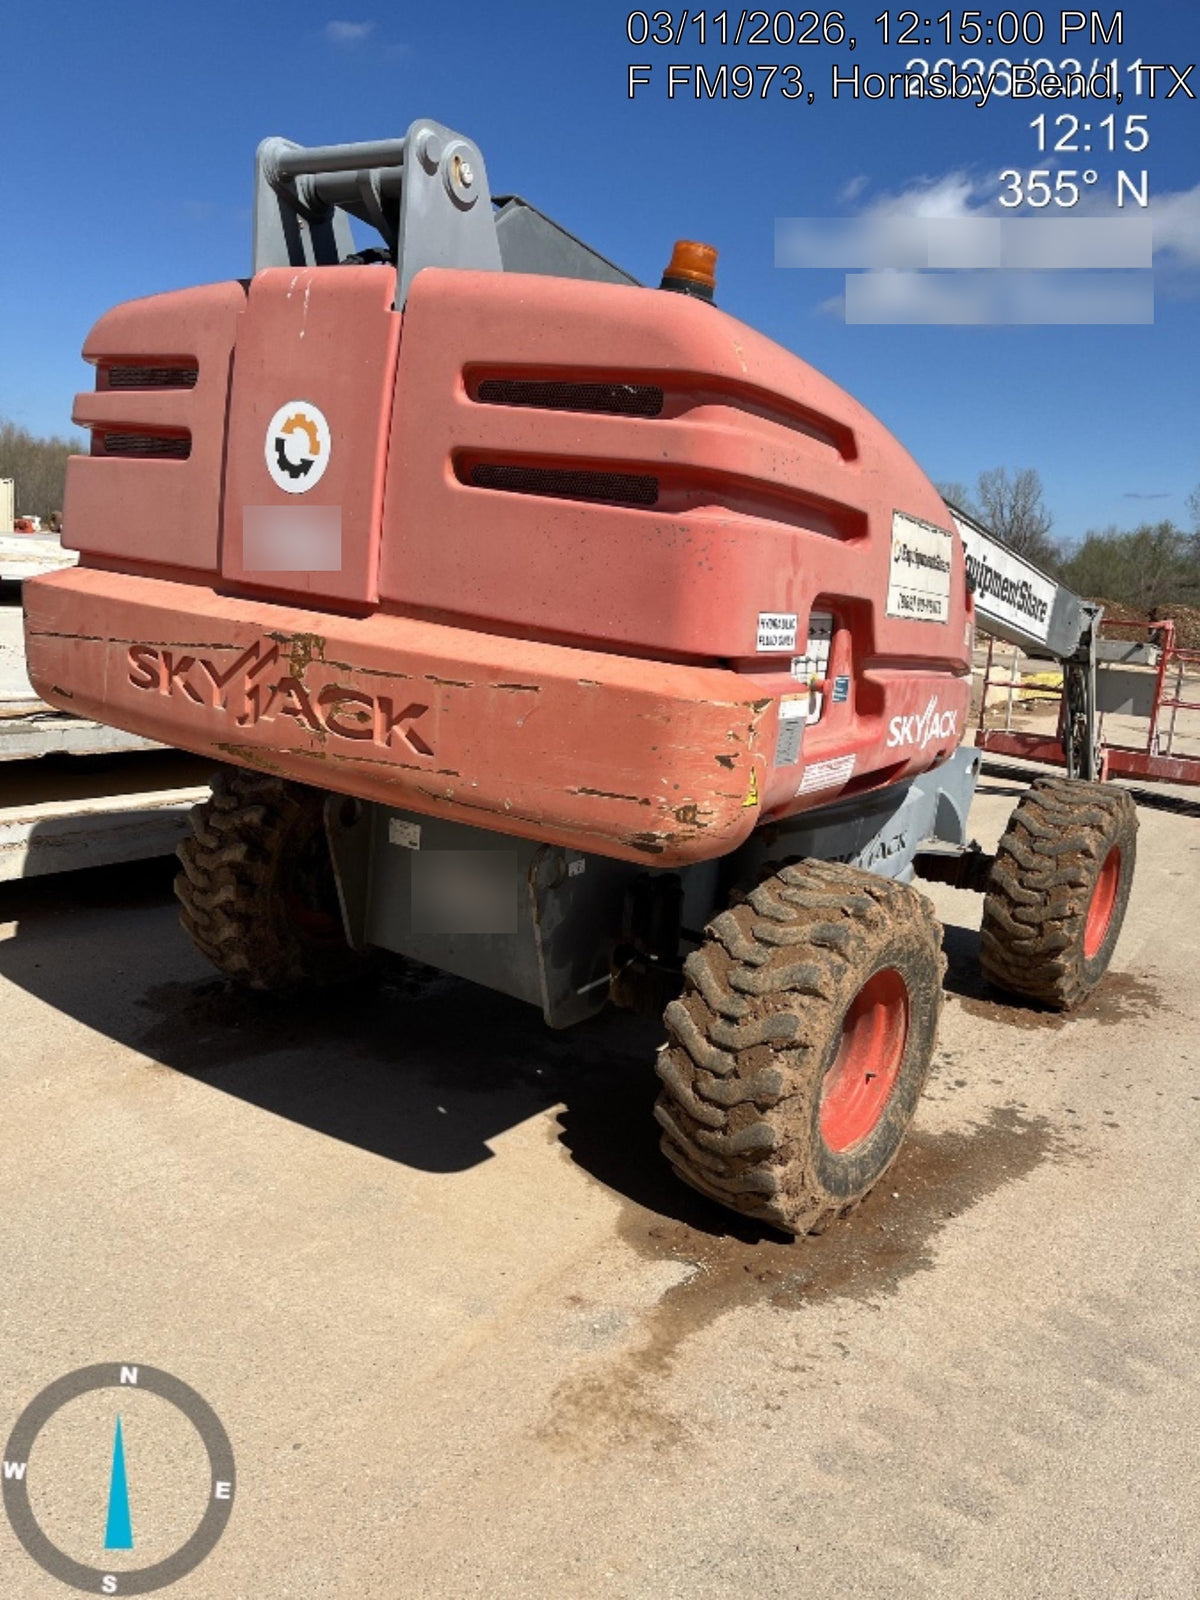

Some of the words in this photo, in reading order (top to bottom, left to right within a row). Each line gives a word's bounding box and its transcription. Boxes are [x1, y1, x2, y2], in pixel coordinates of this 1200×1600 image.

[961, 540, 1048, 623] quipmentShare
[127, 639, 435, 757] SKYJACK
[886, 694, 958, 750] SKYJACK
